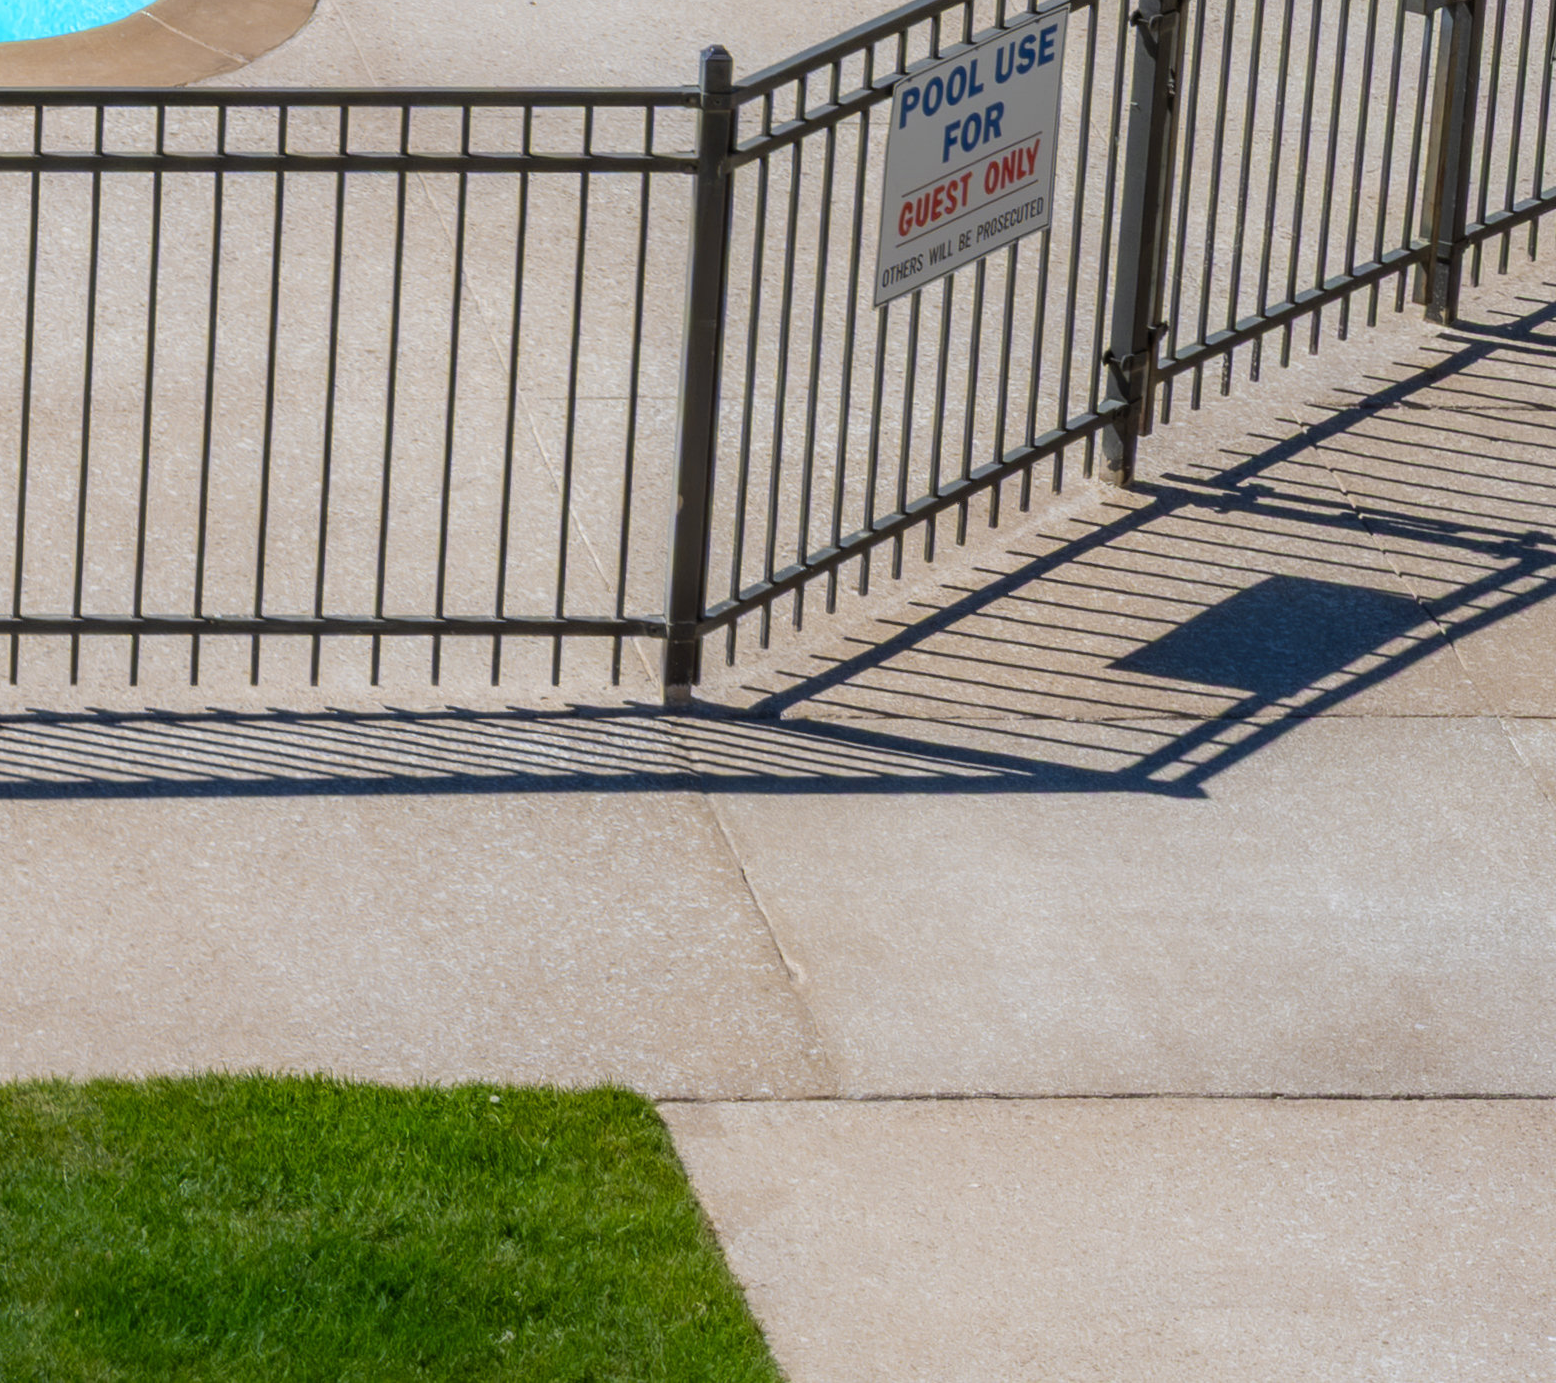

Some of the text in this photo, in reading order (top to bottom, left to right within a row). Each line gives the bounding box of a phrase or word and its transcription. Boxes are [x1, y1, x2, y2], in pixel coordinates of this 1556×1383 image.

[898, 23, 1058, 130] POOL USE
[942, 100, 1005, 164] FOR
[897, 138, 1040, 237] GUEST ONLY
[881, 196, 1044, 289] OTHERS WILL BE PROSECUTED
